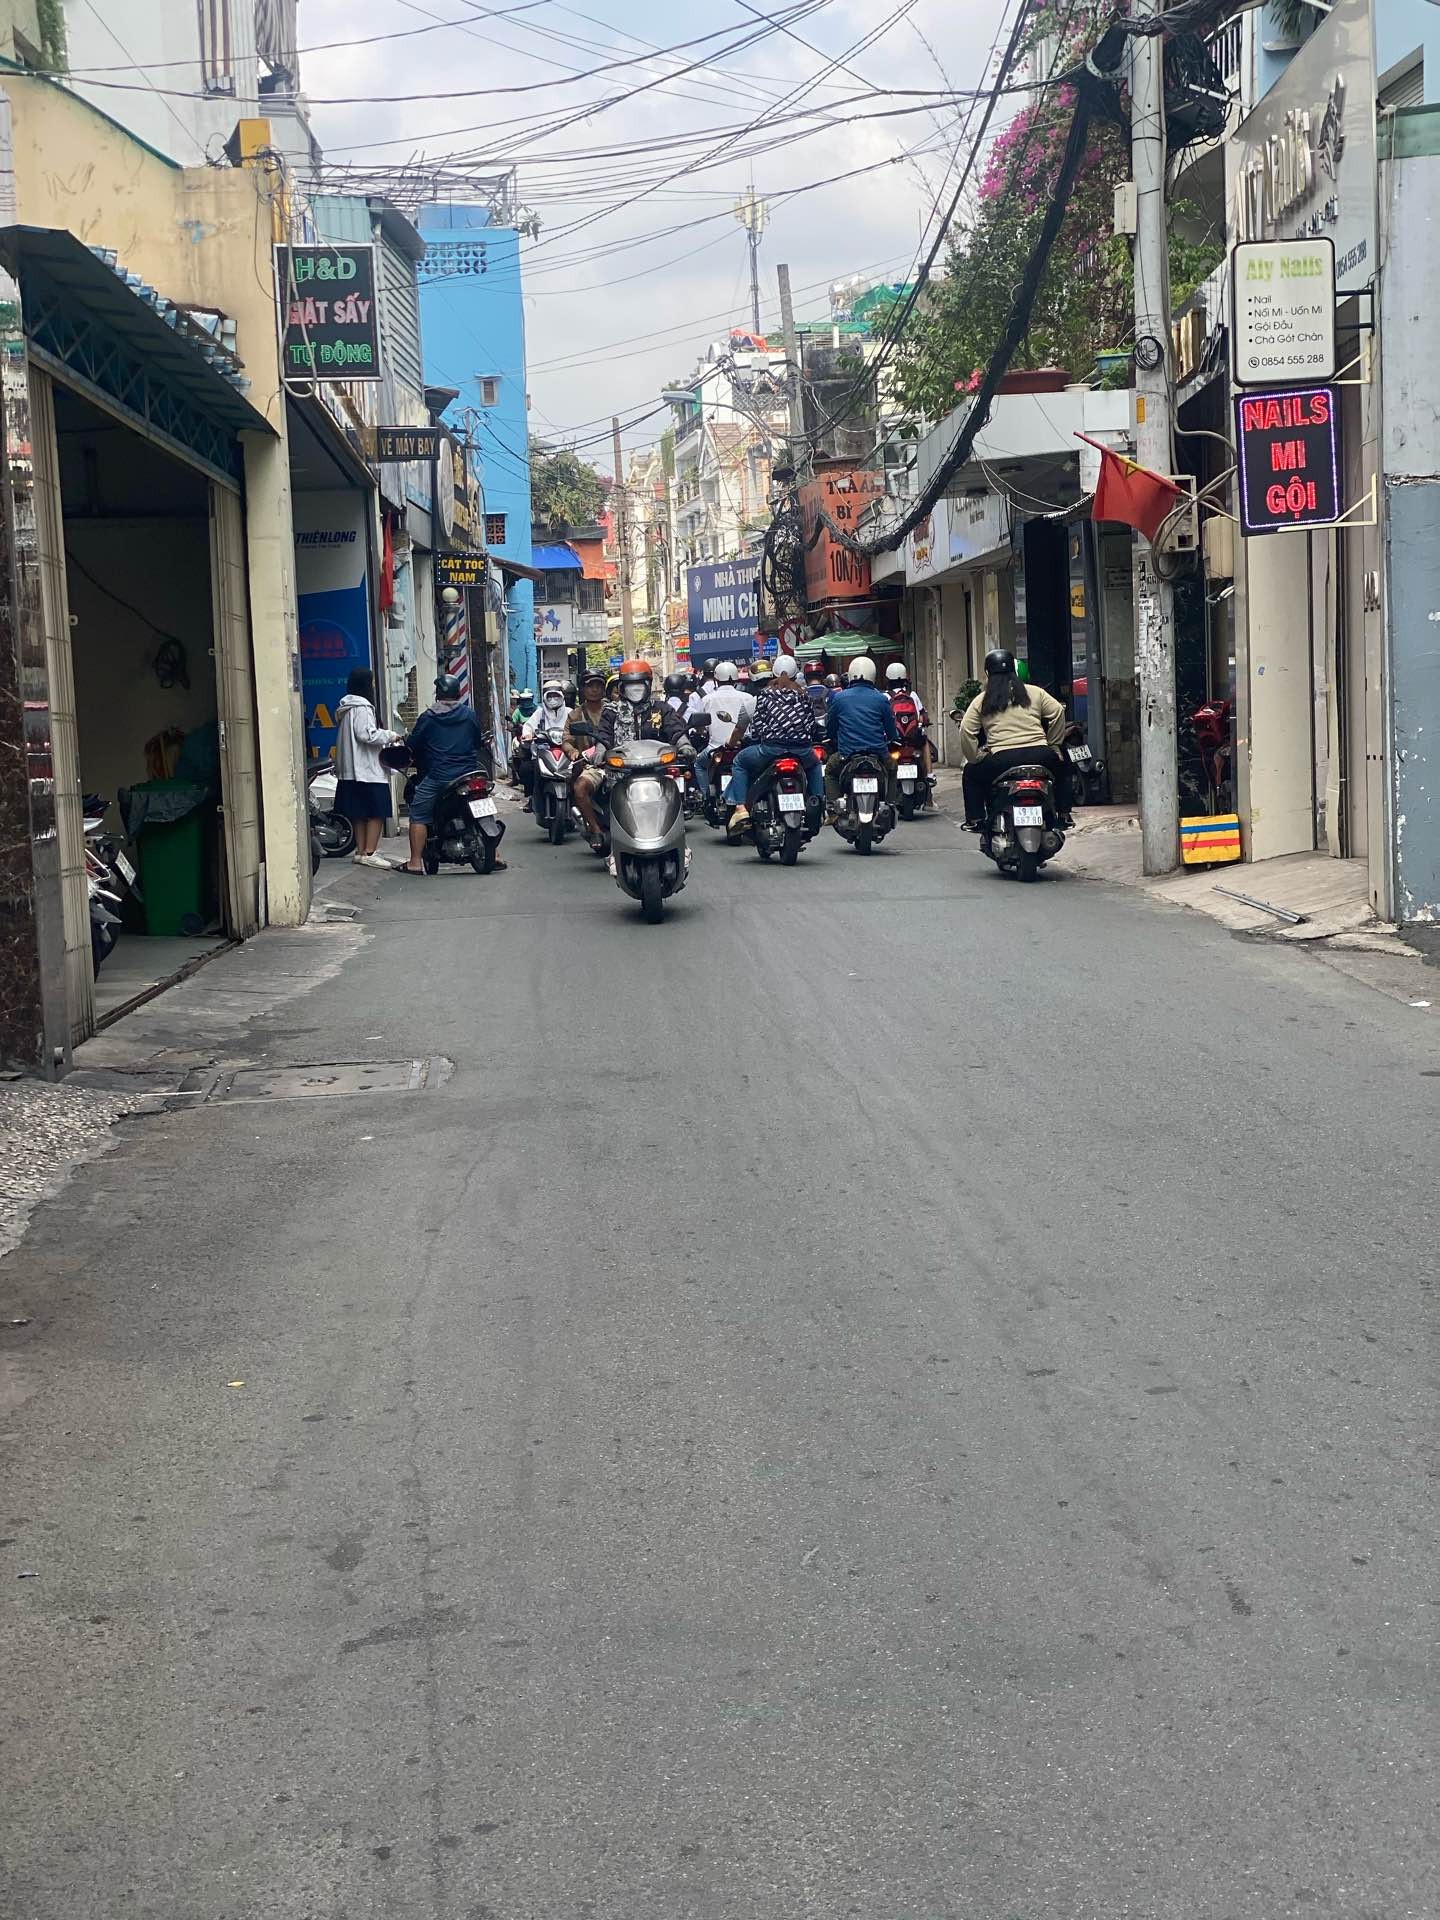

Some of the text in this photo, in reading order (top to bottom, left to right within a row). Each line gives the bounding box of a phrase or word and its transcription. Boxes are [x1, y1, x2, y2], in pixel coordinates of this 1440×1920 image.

[295, 257, 357, 280] H&D
[333, 292, 370, 324] SẤY
[1253, 295, 1272, 304] Nail
[320, 339, 373, 366] ĐỘNG
[1261, 354, 1324, 367] 0854 555 288
[1243, 395, 1329, 432] NAILS
[417, 437, 436, 455] BAY
[1270, 440, 1307, 472] MI
[1266, 475, 1317, 519] GỘI
[449, 571, 476, 582] NAM
[714, 564, 736, 589] NHÀ
[702, 594, 735, 623] MINH
